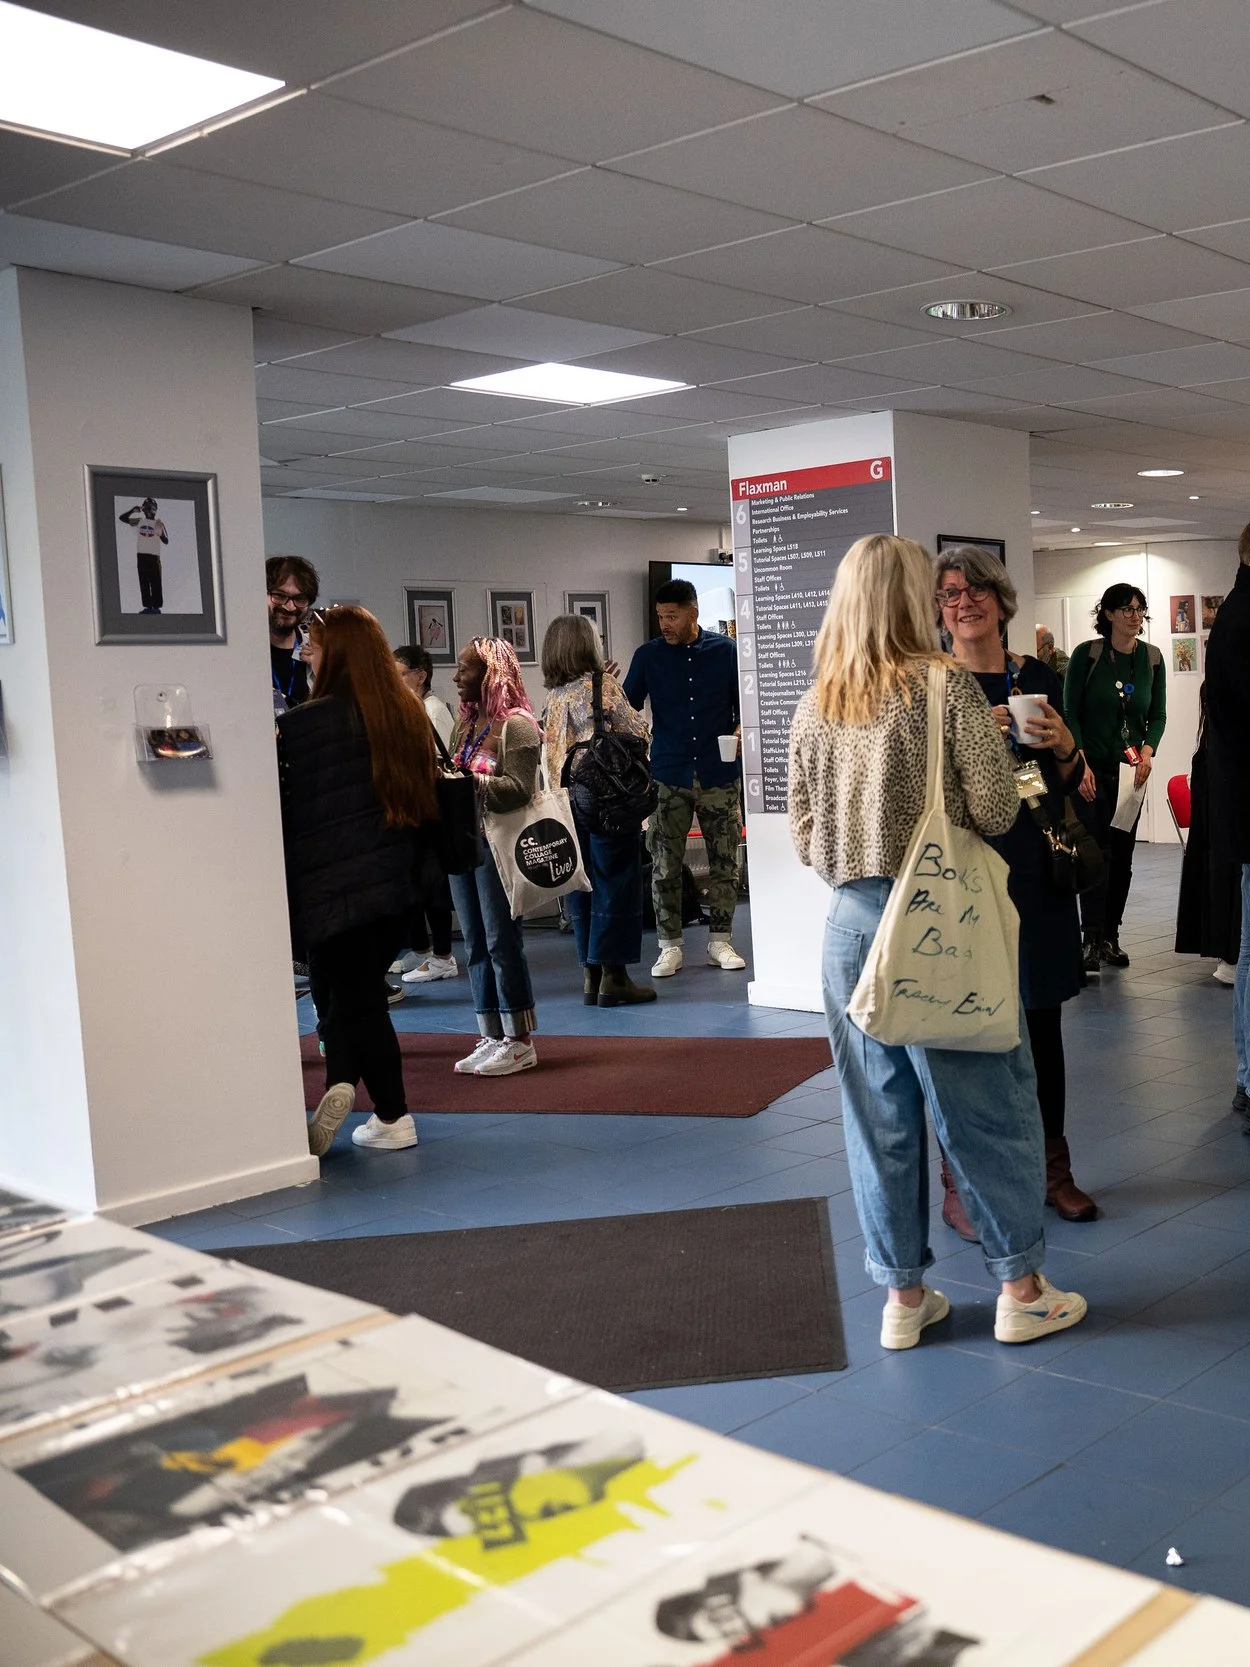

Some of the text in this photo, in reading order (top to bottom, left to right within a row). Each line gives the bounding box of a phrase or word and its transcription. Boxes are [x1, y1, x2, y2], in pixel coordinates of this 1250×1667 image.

[870, 460, 884, 480] G
[738, 480, 788, 497] Flaxman
[752, 498, 774, 506] Marketing
[794, 492, 815, 501] Relations
[736, 504, 747, 526] 6
[752, 506, 779, 515] International
[752, 516, 772, 525] Research
[798, 510, 828, 519] Employability
[828, 508, 849, 516] Services
[752, 526, 780, 535] Partnerships
[738, 552, 748, 573] 5
[754, 566, 779, 574] Uncommon
[740, 600, 751, 620] 4
[742, 638, 752, 658] 3
[744, 674, 754, 695] 2
[748, 732, 756, 752] 1
[748, 778, 760, 797] G
[522, 837, 568, 855] CONTEMPORARY
[524, 848, 553, 861] COLLAGE
[525, 852, 560, 867] MAGAZINE
